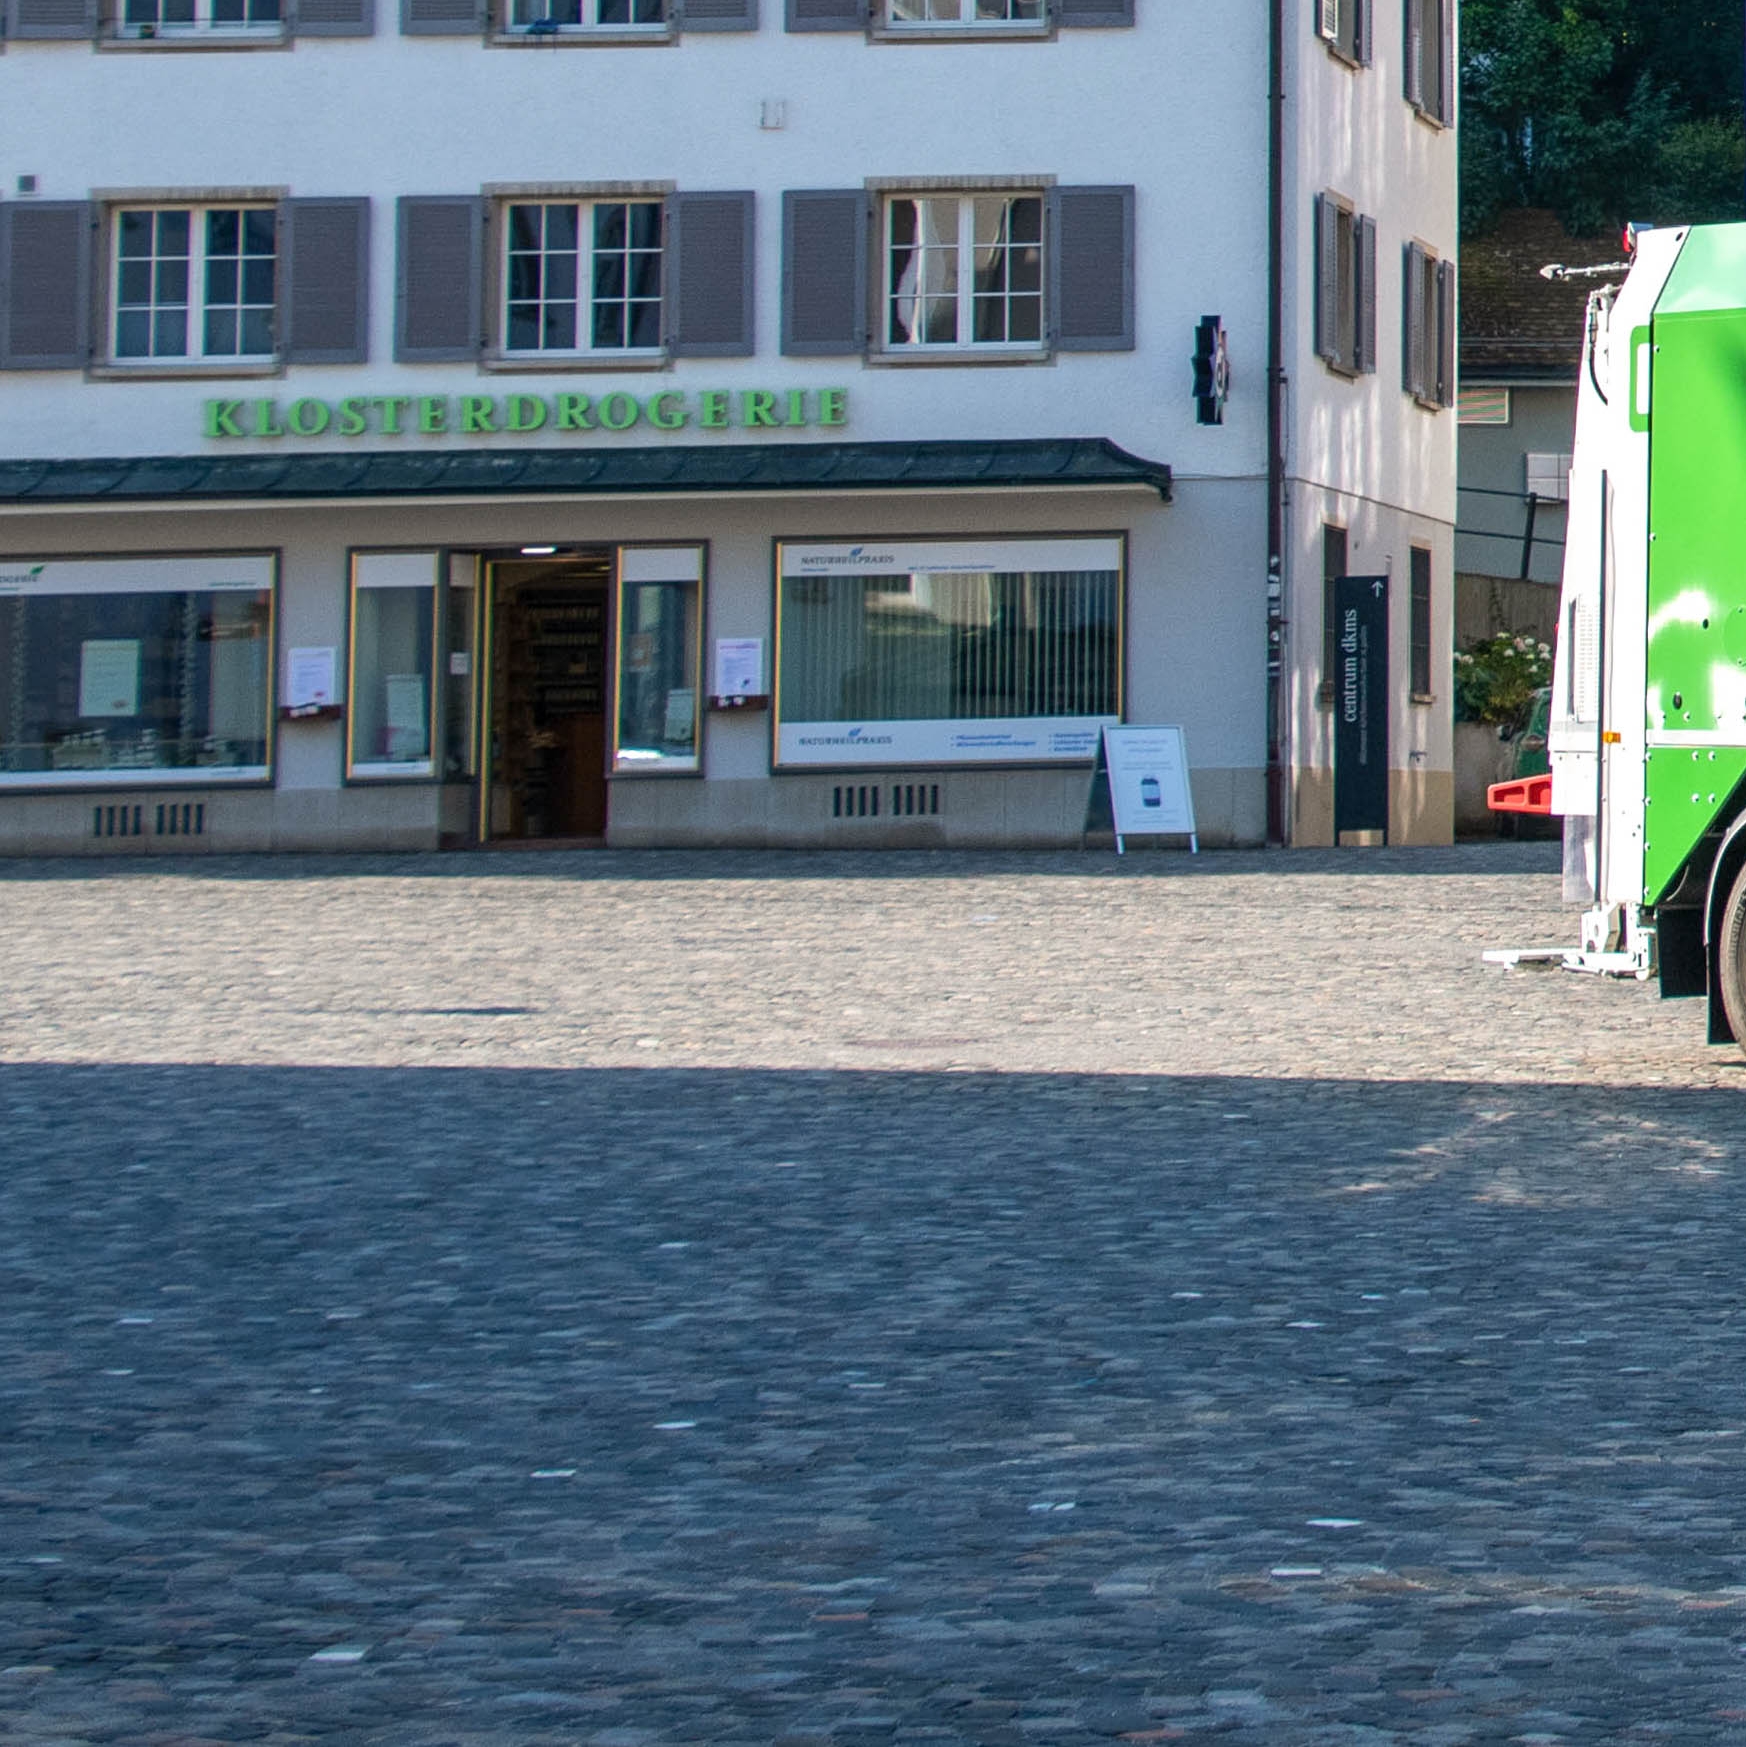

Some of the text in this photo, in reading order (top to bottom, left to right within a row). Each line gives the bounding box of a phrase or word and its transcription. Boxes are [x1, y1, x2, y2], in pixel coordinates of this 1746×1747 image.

[202, 389, 849, 437] KLOSTERDROGERIE
[1341, 609, 1358, 722] centrum dkms
